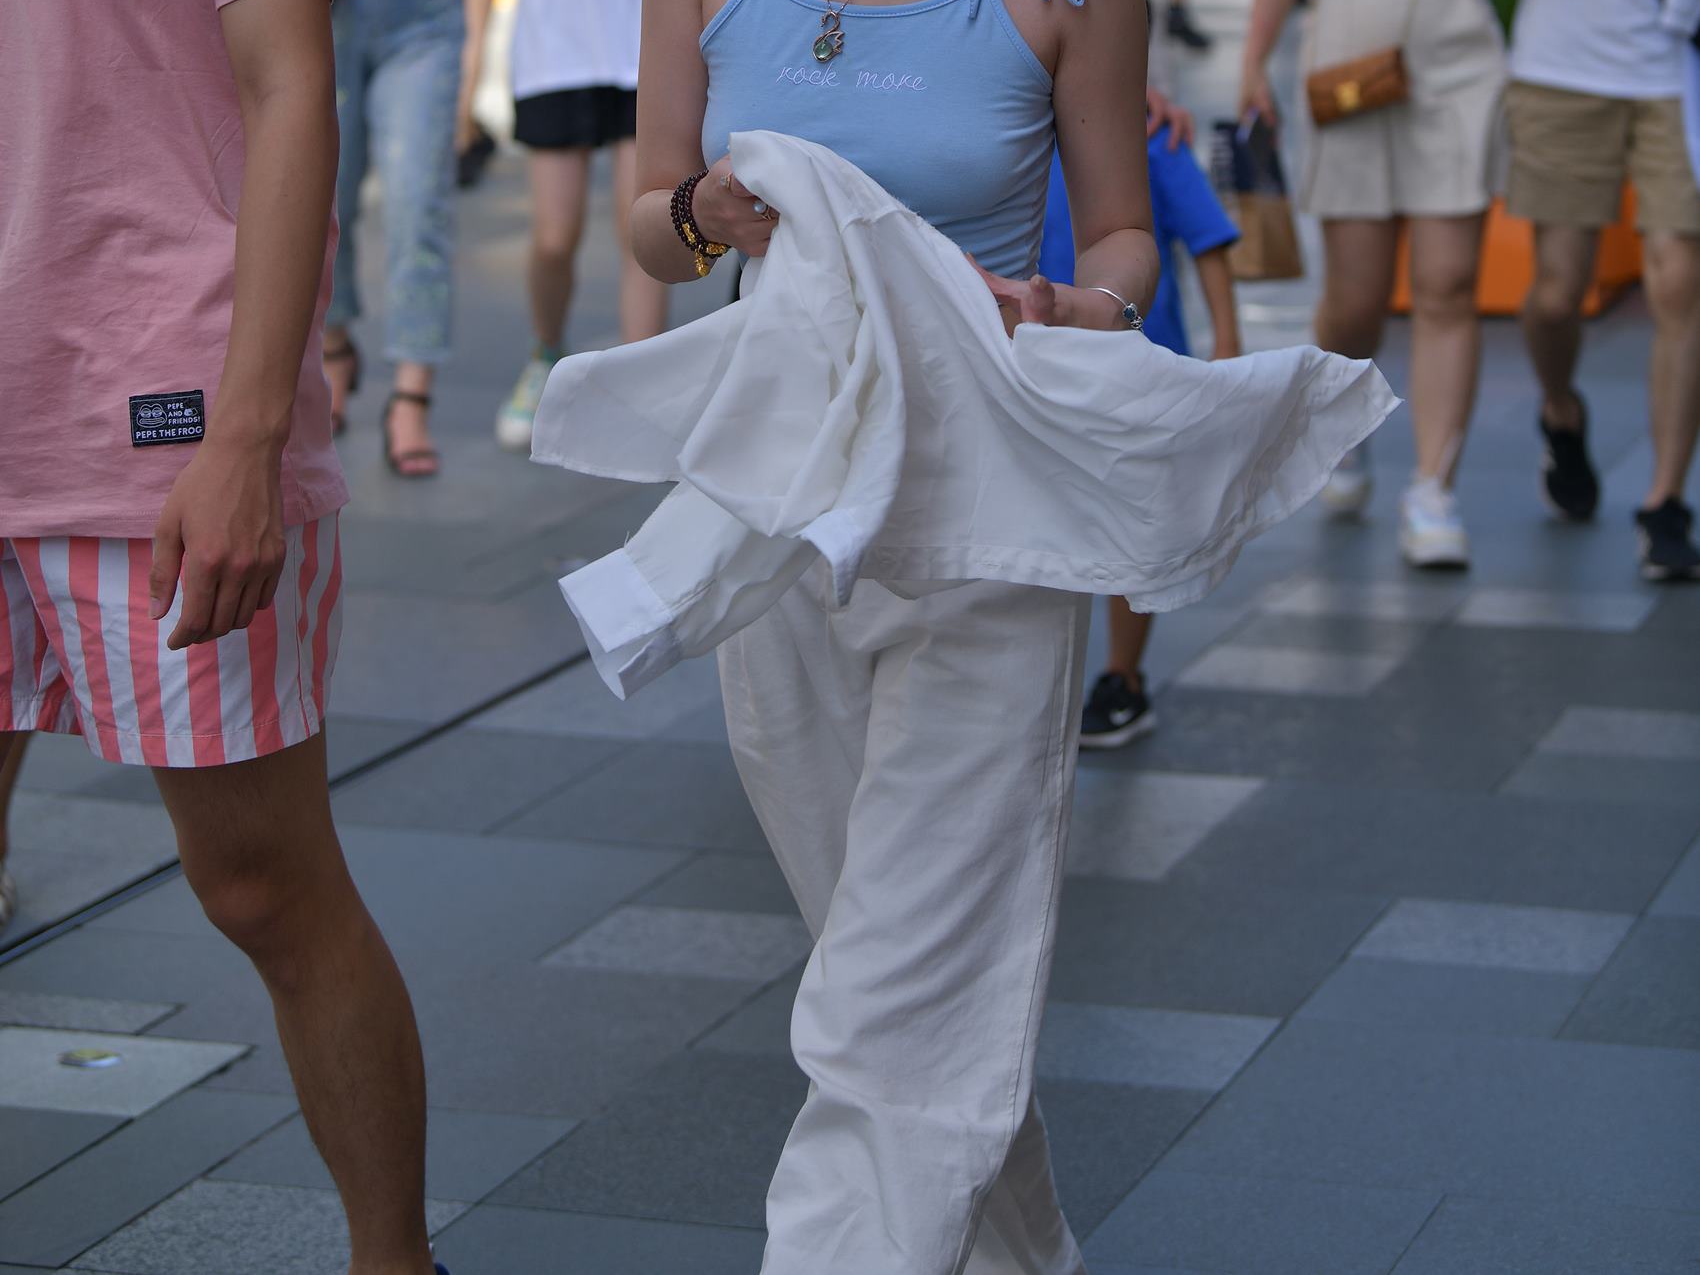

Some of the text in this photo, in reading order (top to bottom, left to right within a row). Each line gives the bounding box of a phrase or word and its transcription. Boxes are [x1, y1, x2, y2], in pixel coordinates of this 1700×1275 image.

[776, 62, 928, 91] rock more
[167, 402, 184, 410] PEPE
[168, 416, 200, 425] FRIENDS!
[135, 425, 203, 439] PEPE THE FROG
